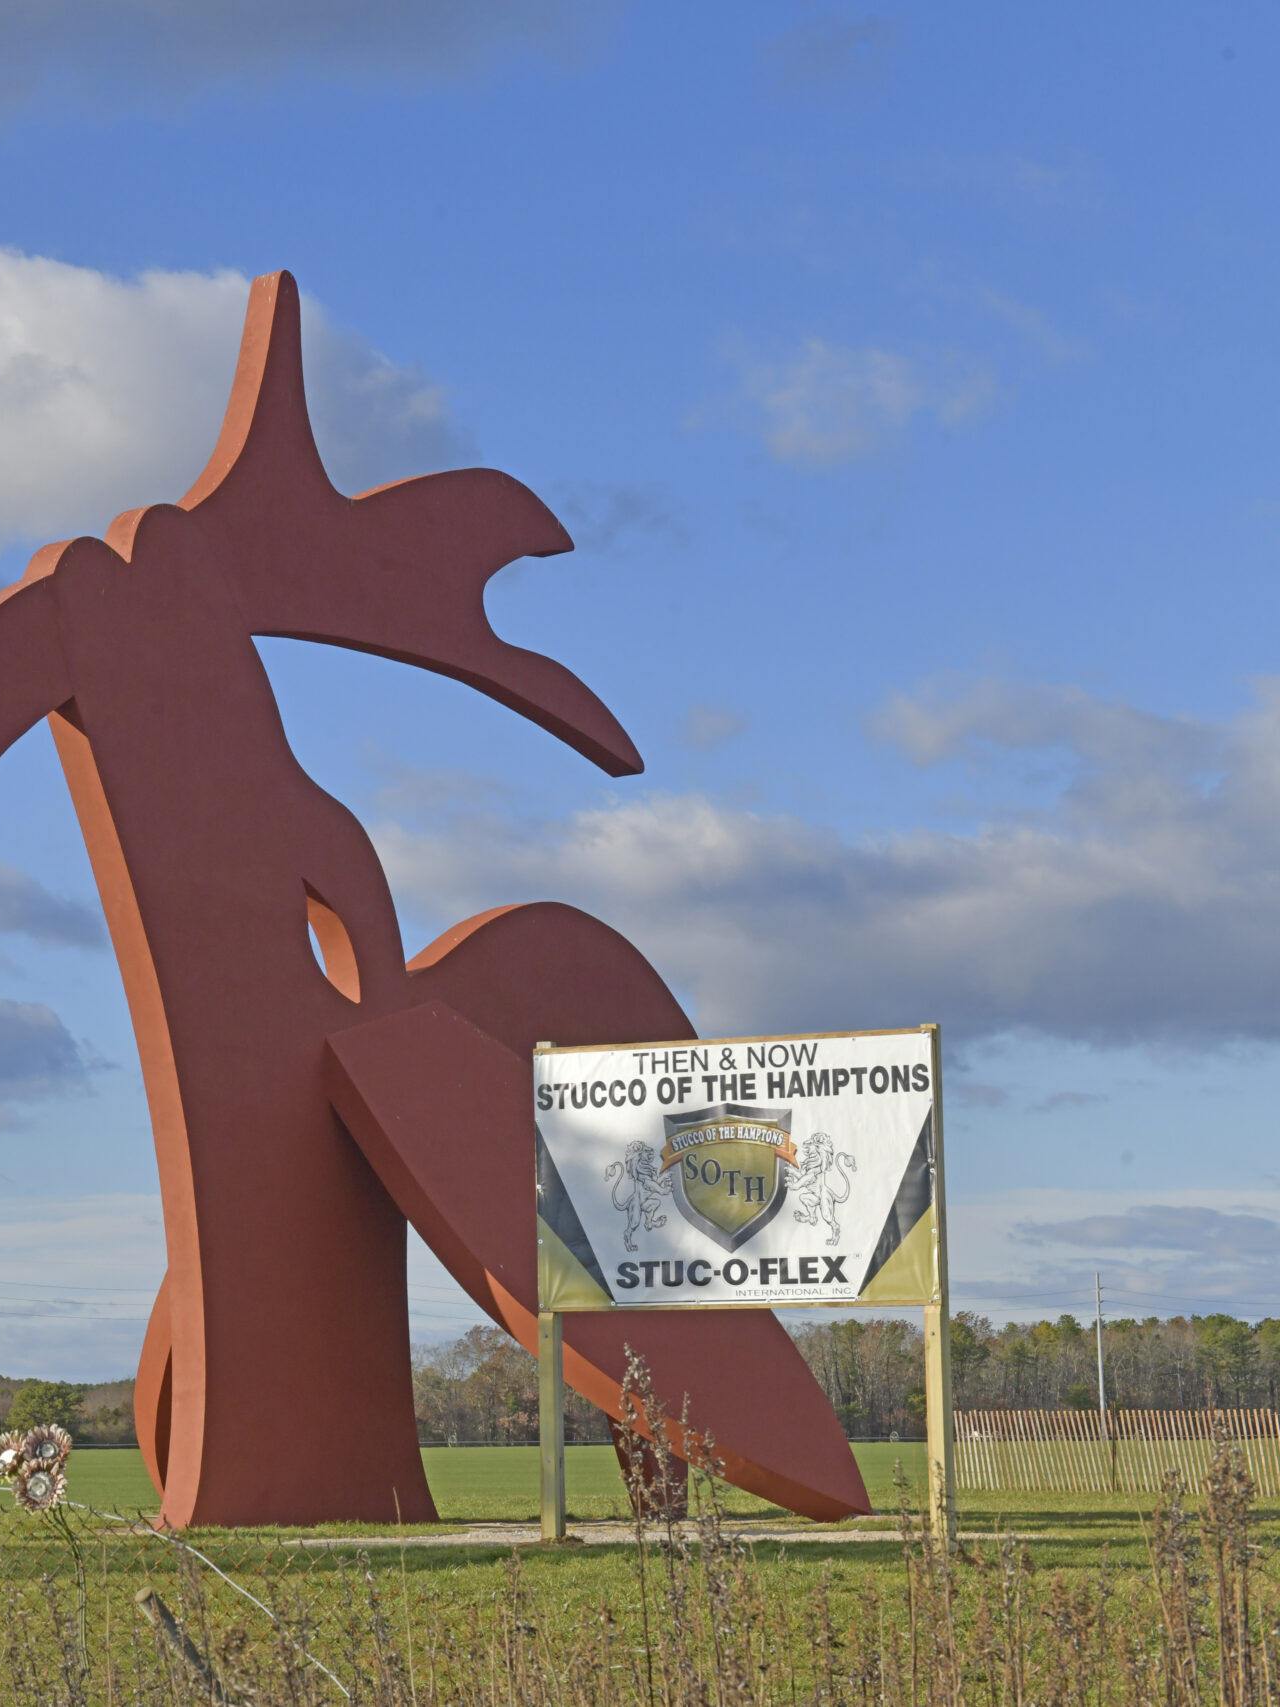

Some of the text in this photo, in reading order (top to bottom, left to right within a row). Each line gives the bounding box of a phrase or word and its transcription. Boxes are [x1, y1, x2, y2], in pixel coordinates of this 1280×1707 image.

[633, 1042, 819, 1076] THEN & NOW
[537, 1063, 930, 1111] STUCCO OF THE HAMPTONS
[672, 1126, 784, 1151] STUCCO OF THE HAMPTONS
[685, 1153, 766, 1202] SOTH
[616, 1256, 848, 1290] STUC-O-FLEX
